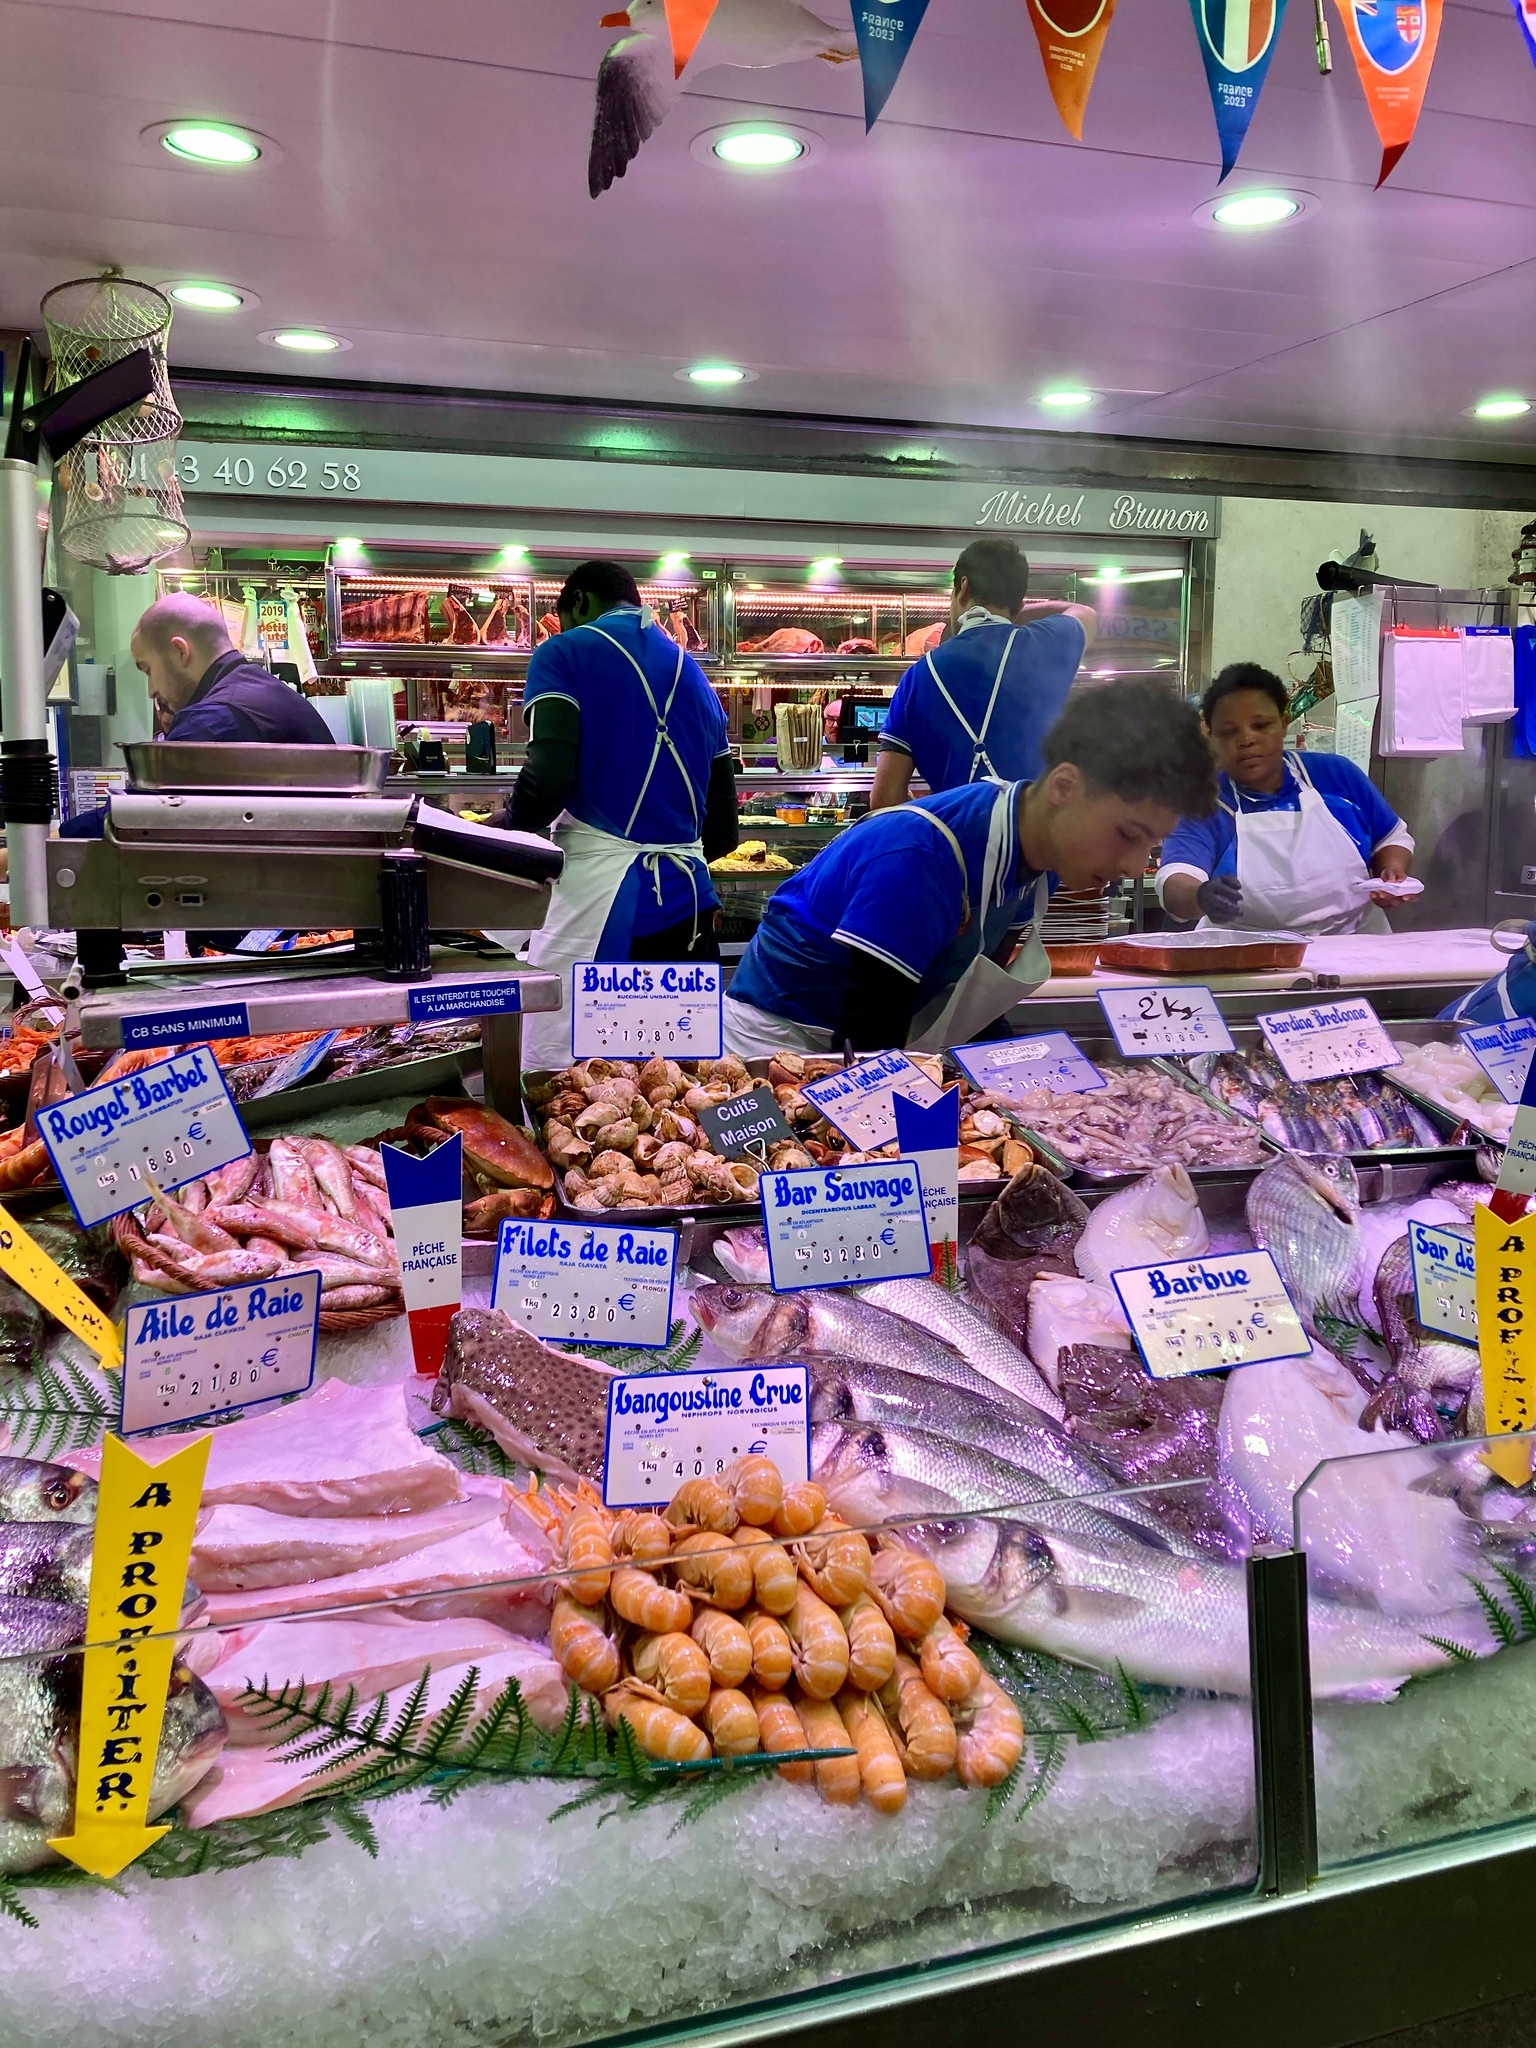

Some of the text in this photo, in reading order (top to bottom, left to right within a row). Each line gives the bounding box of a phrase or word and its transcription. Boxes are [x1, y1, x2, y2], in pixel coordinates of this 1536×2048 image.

[868, 26, 895, 41] 2023
[1224, 95, 1246, 107] 2023
[213, 457, 255, 486] 40
[267, 456, 308, 489] 62
[320, 462, 362, 491] 58
[975, 490, 1209, 532] Michel Brunon
[261, 605, 284, 616] 2019
[582, 966, 717, 992] Bulots Cuits
[414, 988, 516, 1004] IL EST INTERDIT DE TOUCHER
[435, 1004, 446, 1012] LA
[446, 998, 505, 1011] MARCHANDISE
[1138, 996, 1162, 1020] 2
[131, 1015, 242, 1038] CB SANS MINIMUM
[1265, 1013, 1315, 1034] Sardine
[1314, 1006, 1368, 1027] Bretonne
[48, 1054, 208, 1144] Rouget Barbet
[717, 1097, 759, 1122] Cuits
[719, 1115, 777, 1147] Maison
[775, 1172, 914, 1208] Bar Sauvage
[922, 1187, 947, 1198] ÊCHE
[412, 1241, 445, 1256] PÊCHE
[502, 1225, 669, 1266] Filets de Raie
[1416, 1227, 1476, 1272] Sar de
[1497, 1235, 1526, 1253] A
[402, 1254, 457, 1272] FRANÇAISE
[1147, 1263, 1251, 1298] Barbue
[524, 1298, 539, 1309] 1kg
[134, 1287, 304, 1345] Aile de Raie
[159, 1385, 175, 1394] 1kg
[614, 1373, 803, 1424] Langoustine Crue
[681, 1407, 778, 1418] NEPHROPS NORVEGICUS
[641, 1461, 657, 1471] 1kg
[130, 1481, 172, 1509] A
[96, 1530, 163, 1803] PROFITER
